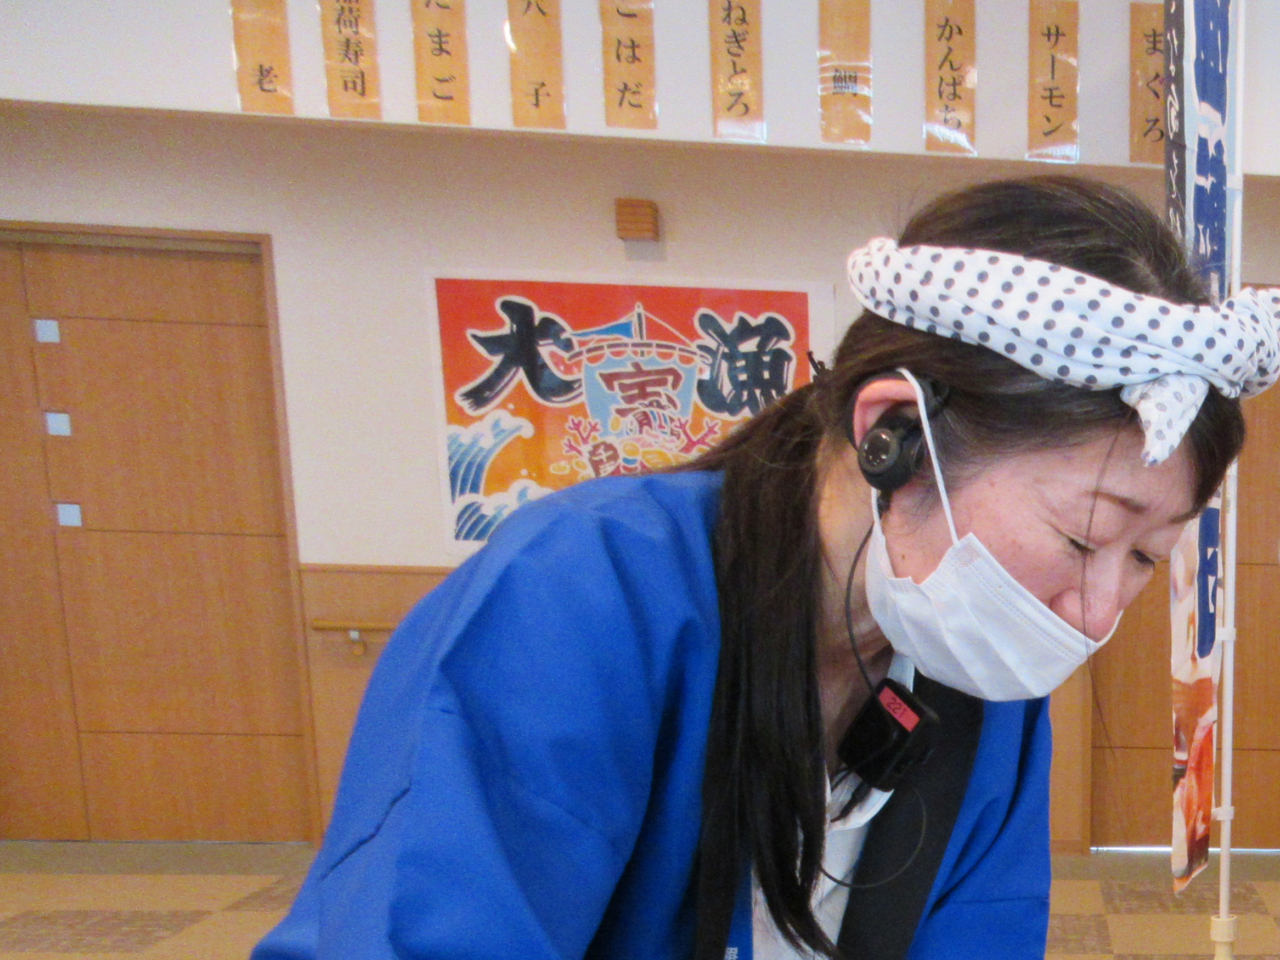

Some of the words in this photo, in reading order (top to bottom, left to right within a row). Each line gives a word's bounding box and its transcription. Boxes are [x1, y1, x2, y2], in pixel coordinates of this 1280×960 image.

[335, 0, 365, 97] 荷寿司
[936, 16, 964, 130] かんぱち
[1041, 25, 1067, 138] サーモン
[1143, 28, 1165, 143] まぐろ
